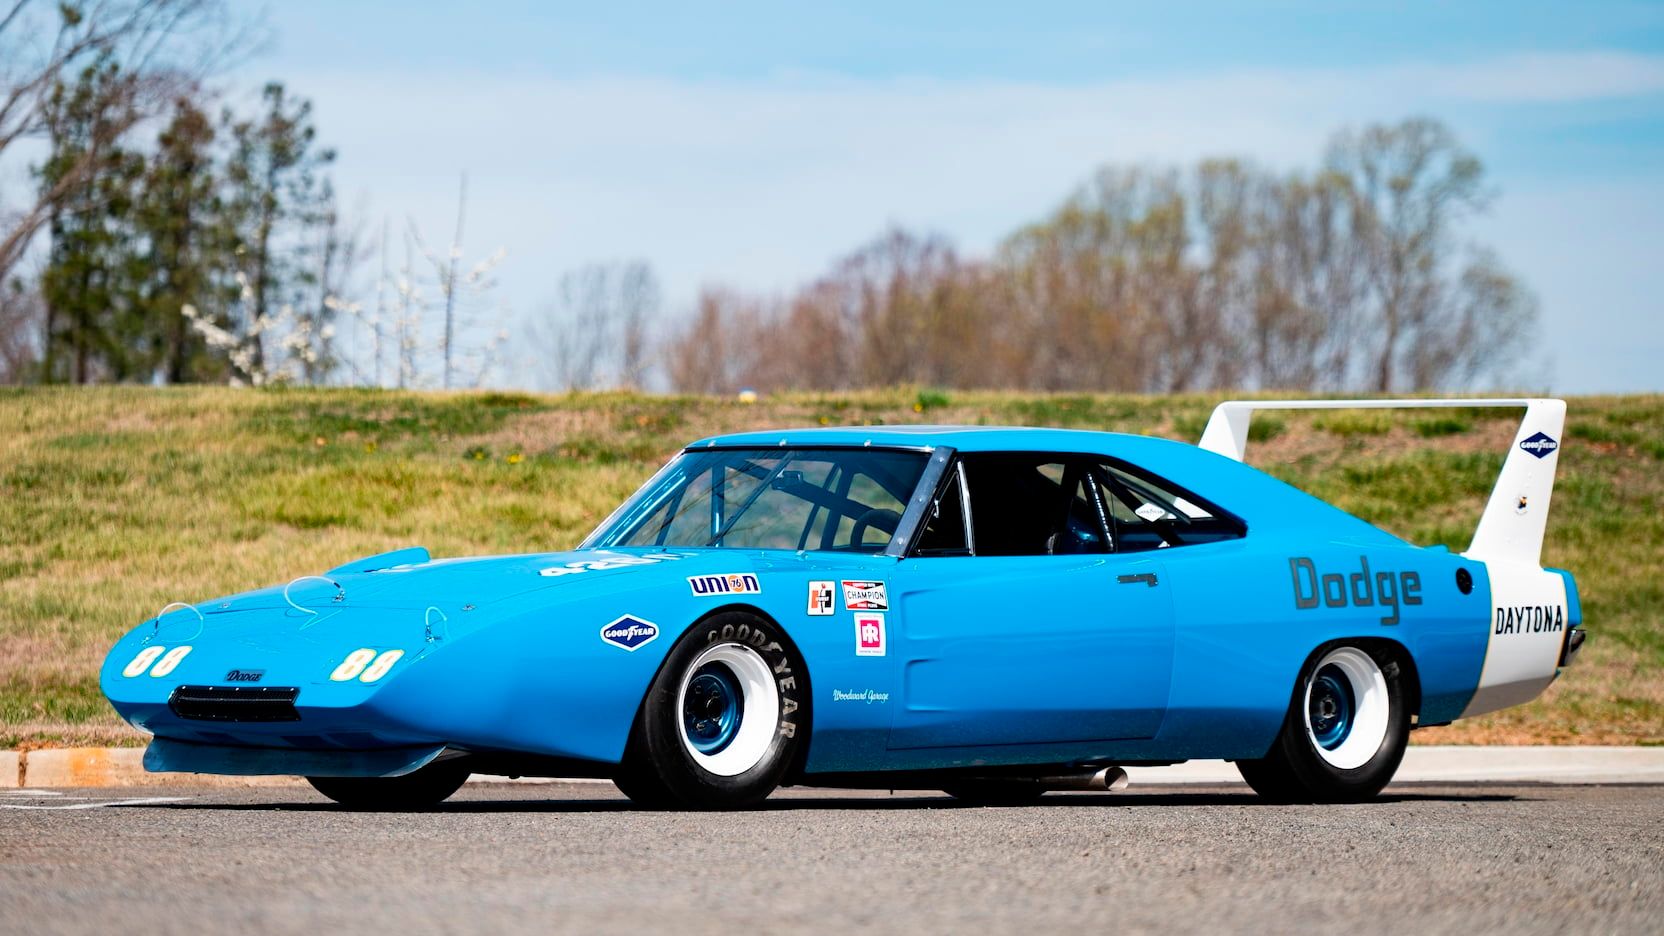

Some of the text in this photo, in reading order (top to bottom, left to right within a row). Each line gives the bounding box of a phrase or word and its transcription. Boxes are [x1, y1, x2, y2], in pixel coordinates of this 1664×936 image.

[731, 578, 742, 588] 76
[847, 590, 885, 600] CHAMPION
[1288, 555, 1423, 626] Dodge
[604, 626, 655, 640] GOODYEAR
[1495, 605, 1563, 635] DAYTONA
[122, 645, 192, 677] 88
[329, 648, 405, 683] 88
[707, 624, 798, 739] GOODYEAR
[832, 688, 889, 704] Woodward Garage
